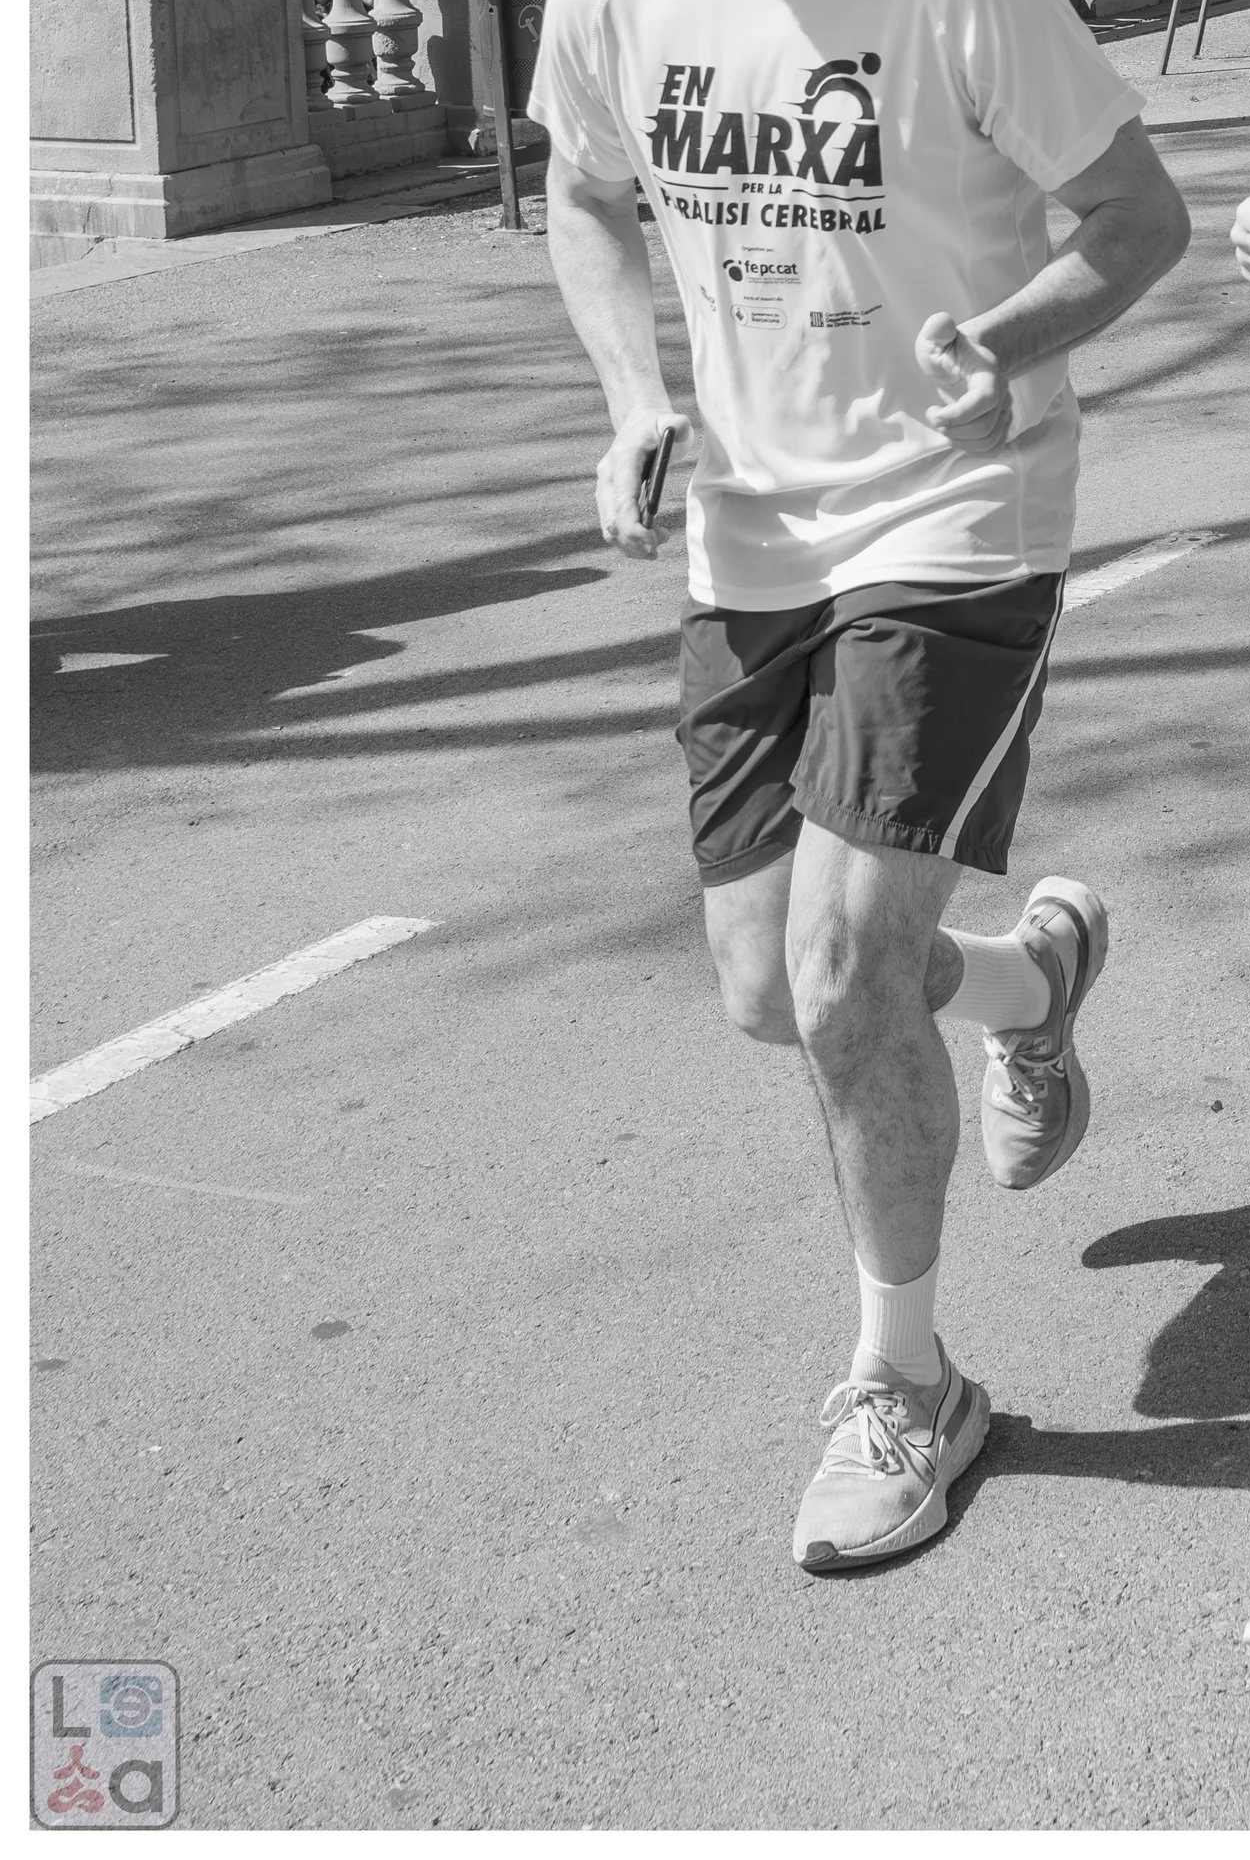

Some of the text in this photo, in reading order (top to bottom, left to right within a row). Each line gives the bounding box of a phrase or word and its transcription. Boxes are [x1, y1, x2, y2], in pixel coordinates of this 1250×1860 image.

[657, 64, 716, 108] EN
[638, 108, 884, 187] MARXA
[741, 182, 783, 195] PER LA
[760, 203, 887, 235] CEREBRAL
[744, 260, 799, 276] fepccat
